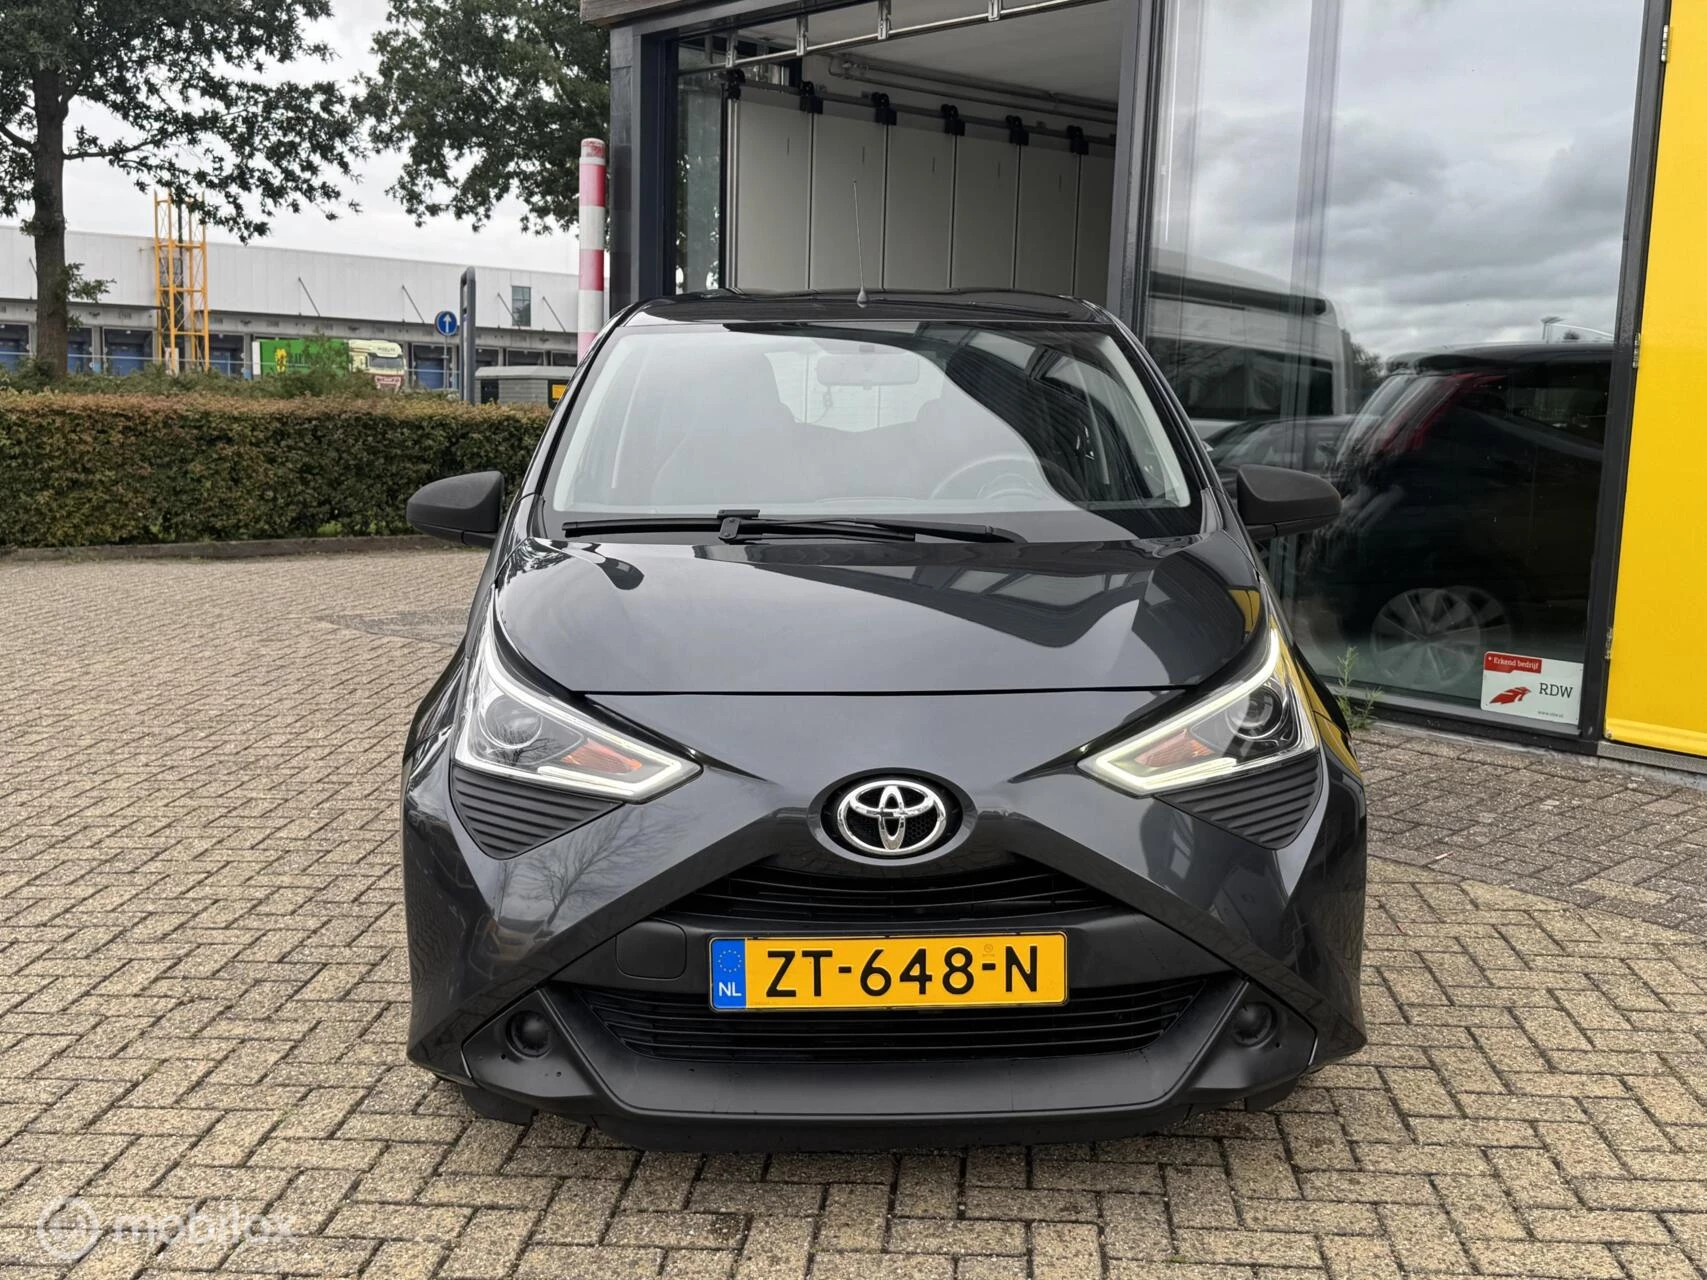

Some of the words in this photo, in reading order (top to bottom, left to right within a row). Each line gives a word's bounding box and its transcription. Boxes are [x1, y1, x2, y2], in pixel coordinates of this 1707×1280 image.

[1493, 657, 1517, 667] Erkend
[1517, 659, 1540, 670] bedrijf
[1538, 682, 1574, 699] RDW
[766, 945, 1038, 998] ZT-648-N
[718, 981, 742, 997] NL
